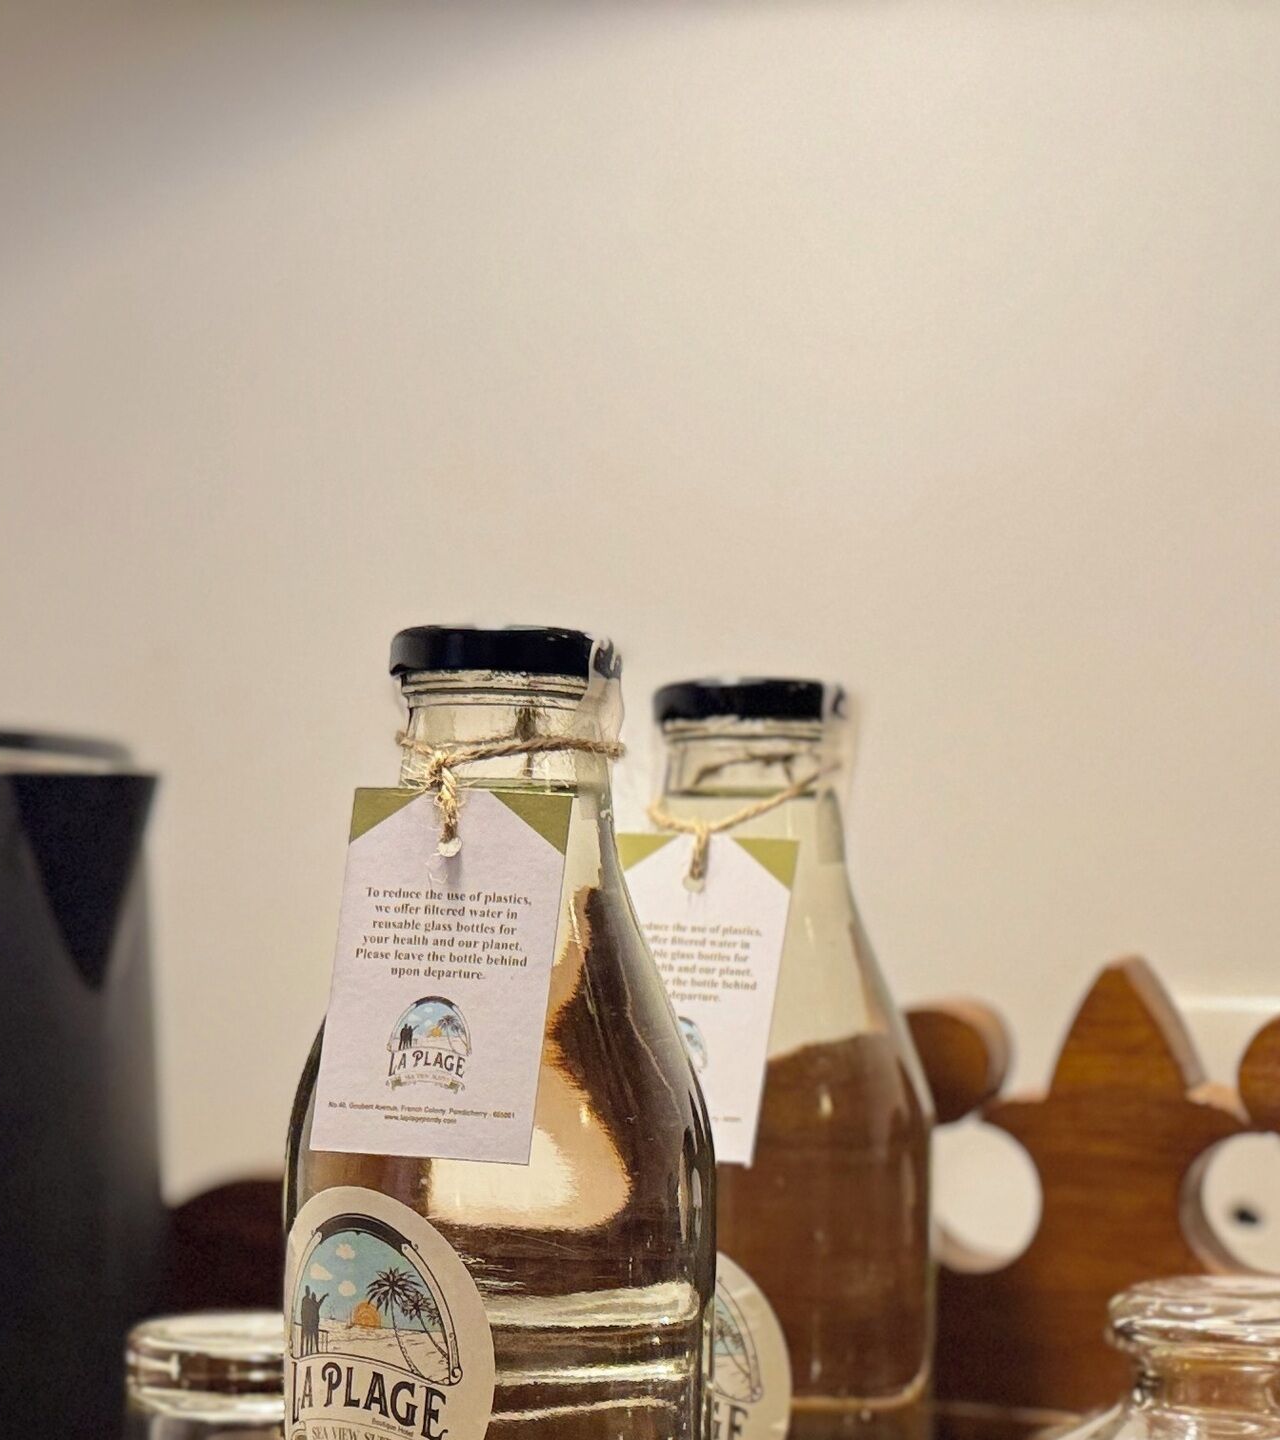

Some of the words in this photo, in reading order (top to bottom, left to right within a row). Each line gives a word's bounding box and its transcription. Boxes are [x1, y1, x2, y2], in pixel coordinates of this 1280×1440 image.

[366, 886, 379, 898] To
[383, 887, 422, 900] reduce
[426, 889, 443, 900] the
[447, 892, 466, 902] use
[469, 891, 483, 902] of
[484, 891, 532, 906] plastics,
[375, 904, 391, 914] we
[394, 903, 421, 915] offer
[424, 904, 465, 917] filtered
[469, 908, 503, 919] water
[506, 908, 518, 920] in
[372, 919, 420, 931] reusable
[424, 920, 452, 933] glass
[456, 922, 495, 934] bottles
[499, 924, 517, 936] for
[672, 922, 687, 932] the
[362, 934, 390, 946] your
[393, 934, 428, 946] health
[432, 936, 455, 947] and
[458, 940, 479, 949] our
[355, 947, 391, 960] Please
[394, 949, 424, 961] leave
[427, 951, 445, 963] the
[449, 952, 483, 965] bottle
[486, 954, 528, 967] behind
[391, 966, 420, 978] upon
[722, 979, 757, 990] behind
[388, 1051, 407, 1077] LA
[412, 1049, 466, 1079] PLAGE
[292, 1361, 314, 1425] LA
[312, 1426, 330, 1440] SEA
